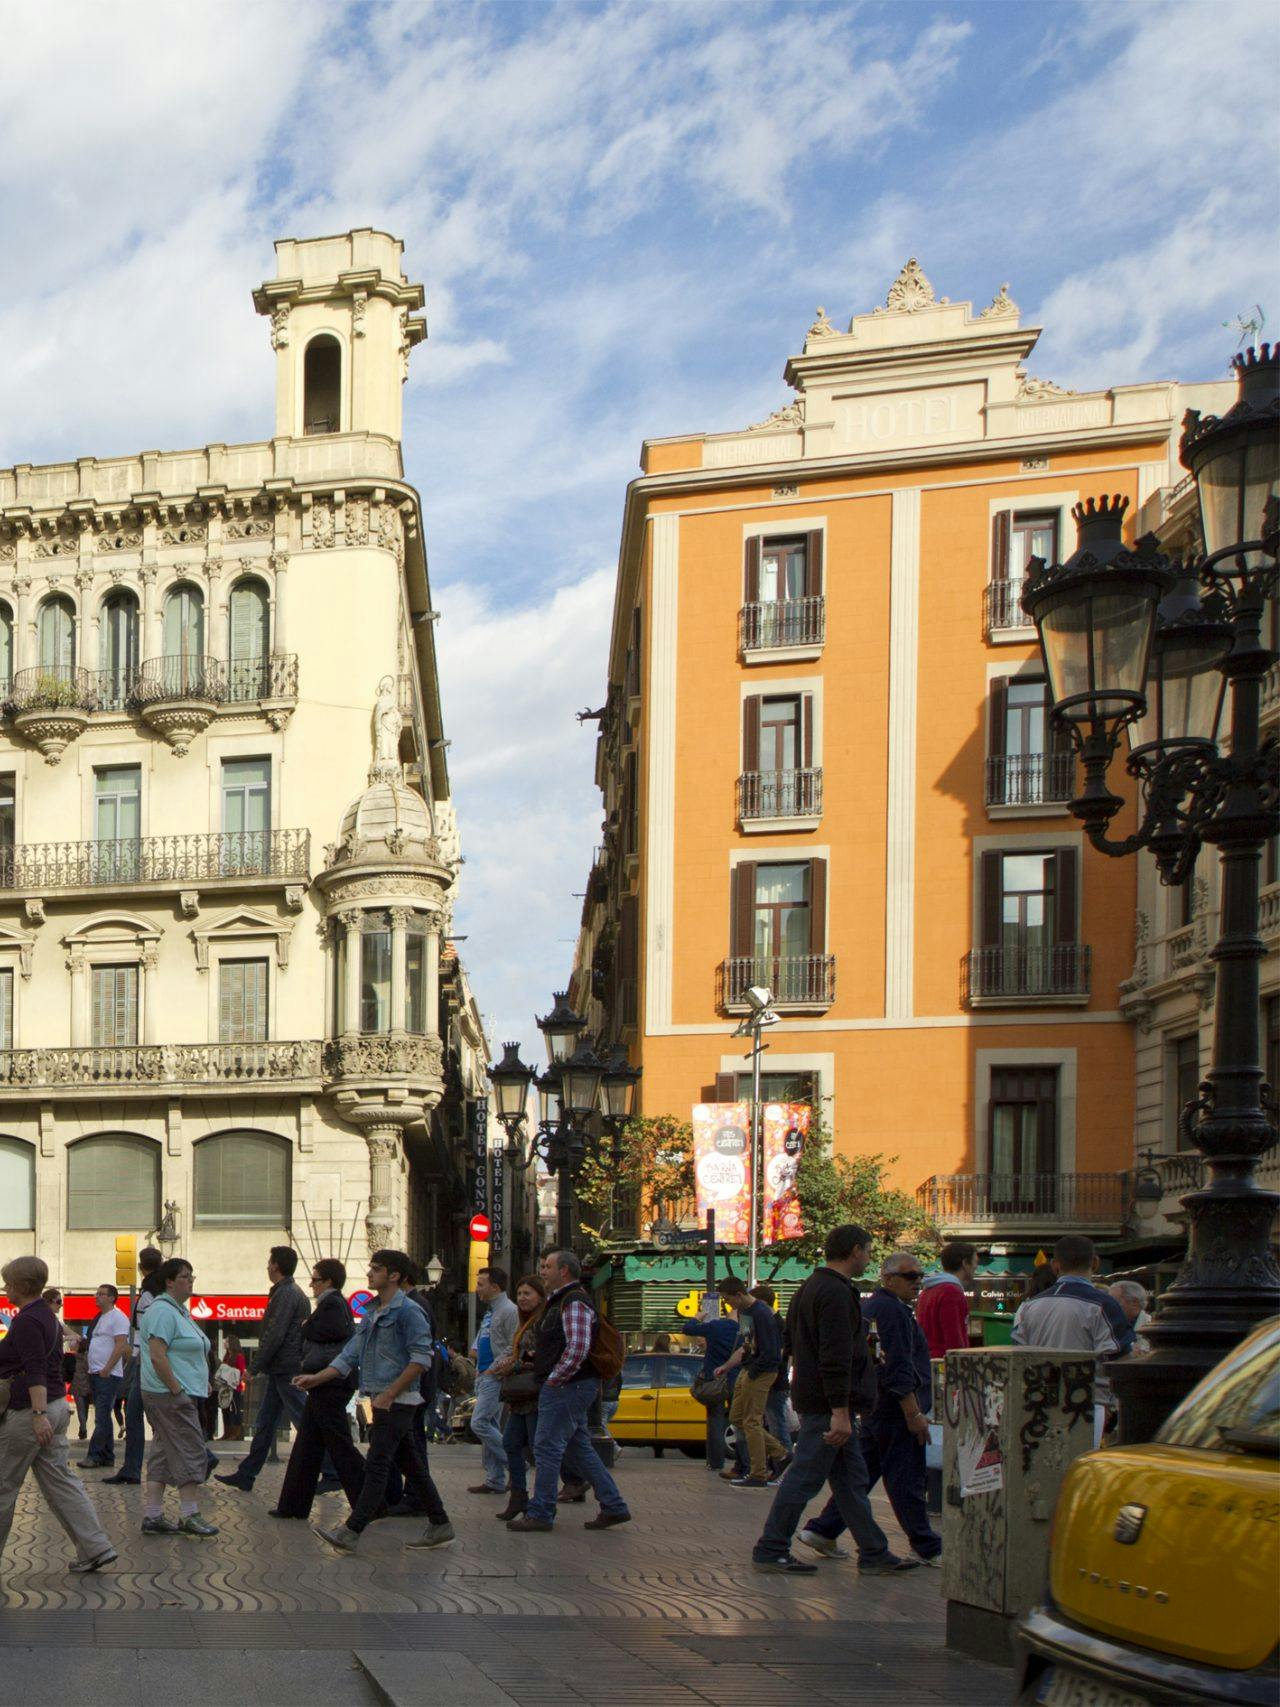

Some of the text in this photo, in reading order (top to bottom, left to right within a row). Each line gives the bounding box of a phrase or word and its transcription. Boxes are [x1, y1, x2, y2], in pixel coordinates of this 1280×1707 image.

[837, 392, 976, 443] HOTEL
[475, 1100, 487, 1157] HOTEL
[493, 1139, 503, 1250] HOTEL CONDAL
[980, 1289, 1004, 1298] Calvin
